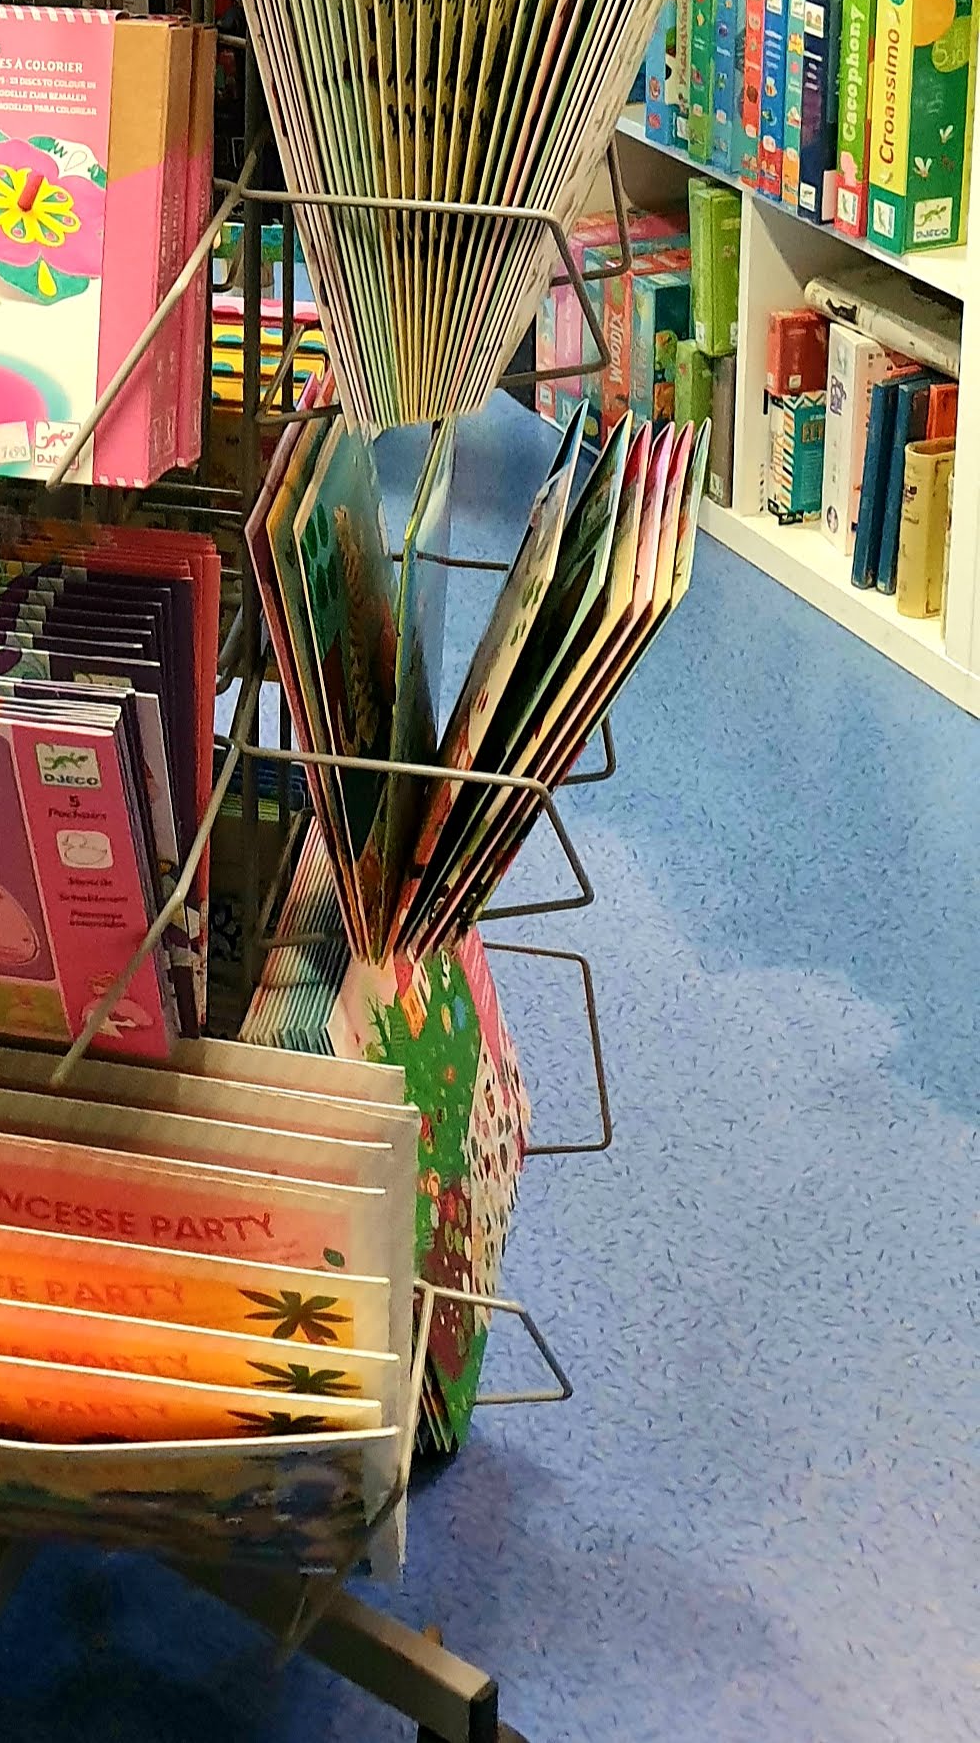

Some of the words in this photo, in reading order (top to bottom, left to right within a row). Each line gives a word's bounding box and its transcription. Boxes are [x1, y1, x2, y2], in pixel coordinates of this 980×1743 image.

[14, 56, 23, 70] À
[25, 60, 83, 73] COLORIER
[842, 4, 866, 142] Cacophony
[879, 27, 900, 164] Croassimo
[609, 310, 624, 385] WOODIX
[43, 774, 100, 786] DJECO
[68, 795, 80, 808] 5
[149, 1212, 275, 1242] PARTY
[45, 1279, 186, 1306] PARTY
